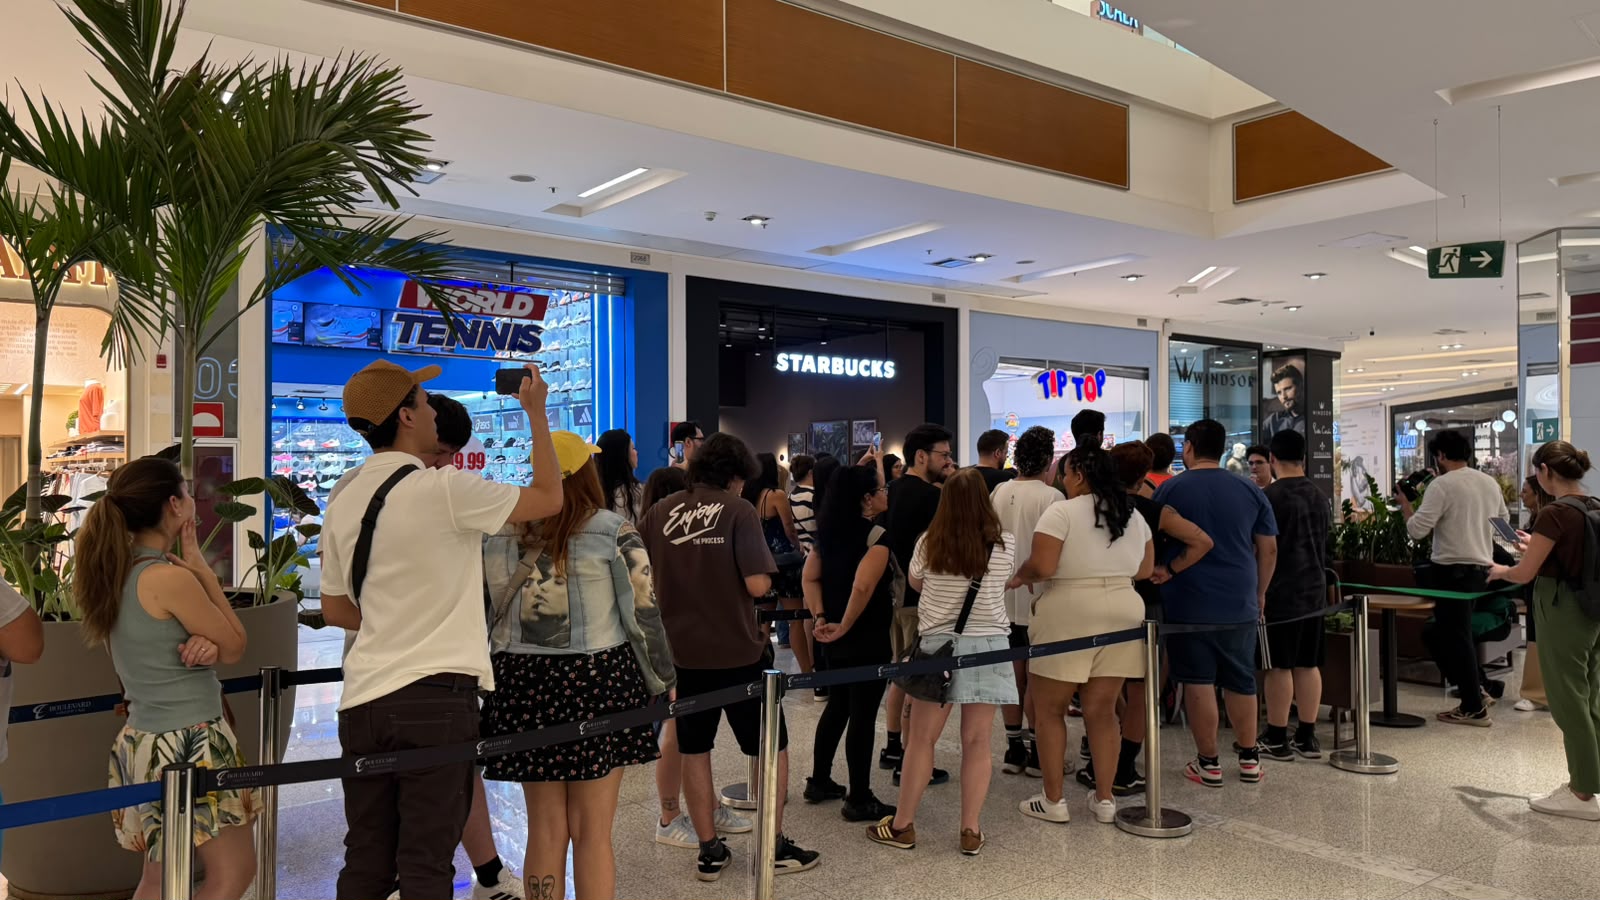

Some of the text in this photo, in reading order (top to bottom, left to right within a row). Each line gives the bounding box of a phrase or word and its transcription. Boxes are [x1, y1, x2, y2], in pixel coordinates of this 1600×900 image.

[416, 283, 535, 317] WORLD
[395, 313, 544, 353] TENNIS
[775, 352, 896, 379] STARBUCKS
[1193, 371, 1255, 388] WINDSOR
[1037, 369, 1106, 402] TIP TOP
[663, 502, 724, 536] Enjoy
[701, 536, 725, 544] PROCESS
[49, 701, 92, 712] BOULEVARD
